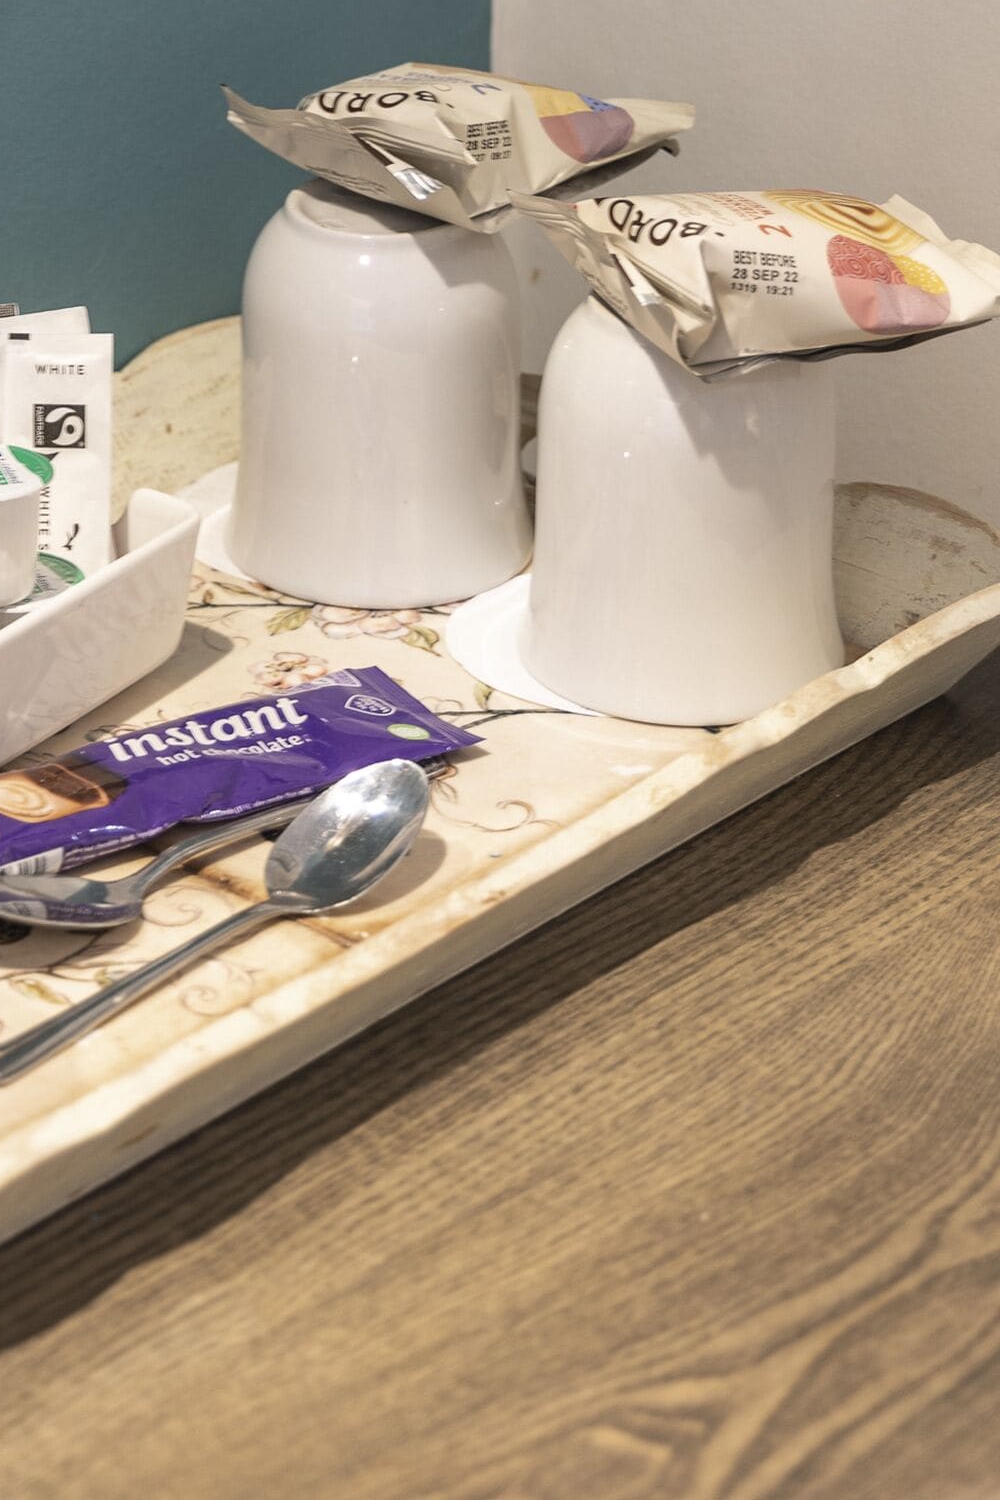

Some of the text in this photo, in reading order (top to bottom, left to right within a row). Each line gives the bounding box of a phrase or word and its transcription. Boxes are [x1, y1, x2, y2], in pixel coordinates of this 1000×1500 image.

[481, 137, 500, 149] SEP
[733, 250, 797, 268] BEST BEFORE
[732, 268, 799, 283] 28 SEP 22
[766, 283, 794, 296] 19:21
[34, 364, 86, 376] WHITE
[34, 405, 46, 447] FAIRTRADE
[40, 485, 50, 537] WHITE
[107, 697, 308, 763] instant
[155, 734, 303, 767] hot chocolate
